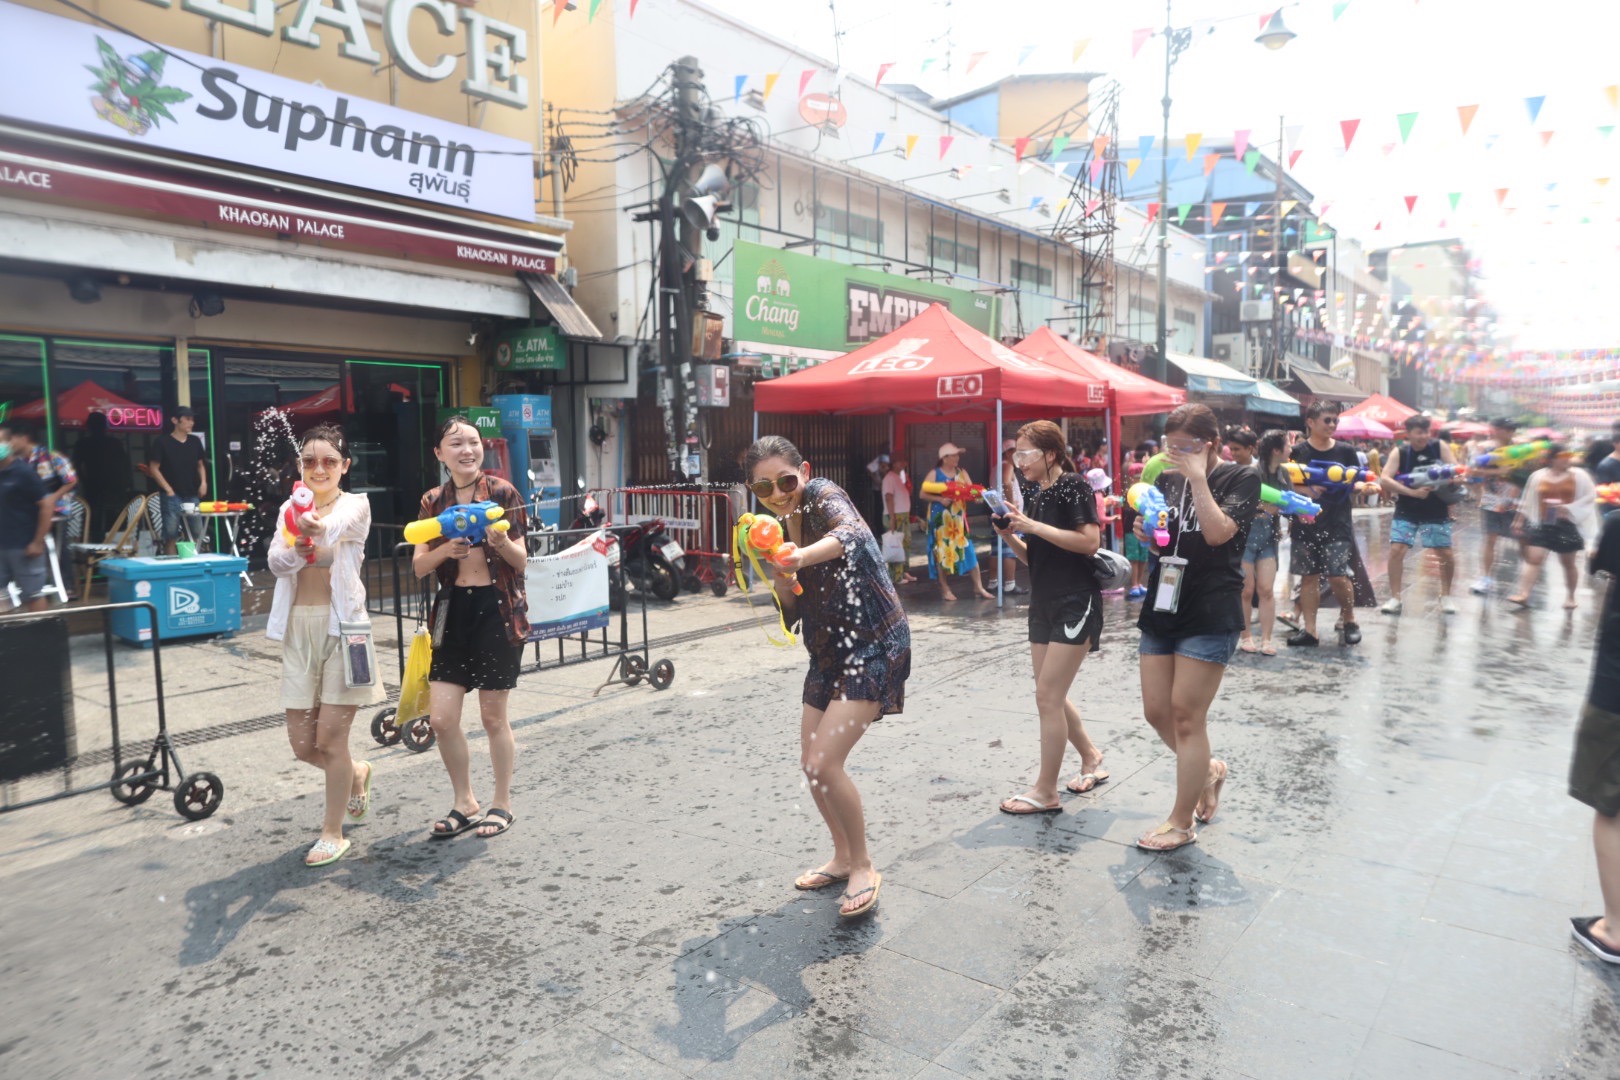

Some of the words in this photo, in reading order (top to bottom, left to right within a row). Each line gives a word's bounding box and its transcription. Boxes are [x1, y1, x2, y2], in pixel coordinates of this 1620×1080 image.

[195, 67, 476, 177] Suphann
[408, 172, 471, 203] สุพันธุ์
[218, 205, 290, 231] KHAOSAN
[296, 218, 345, 239] PALACE
[456, 245, 508, 265] KHAOSAN
[511, 254, 547, 271] PALACE
[746, 294, 800, 331] Chang
[526, 337, 548, 352] ATM
[854, 357, 927, 372] LEO
[940, 376, 981, 395] LEO
[108, 407, 162, 426] OPEN
[475, 416, 497, 428] ATM
